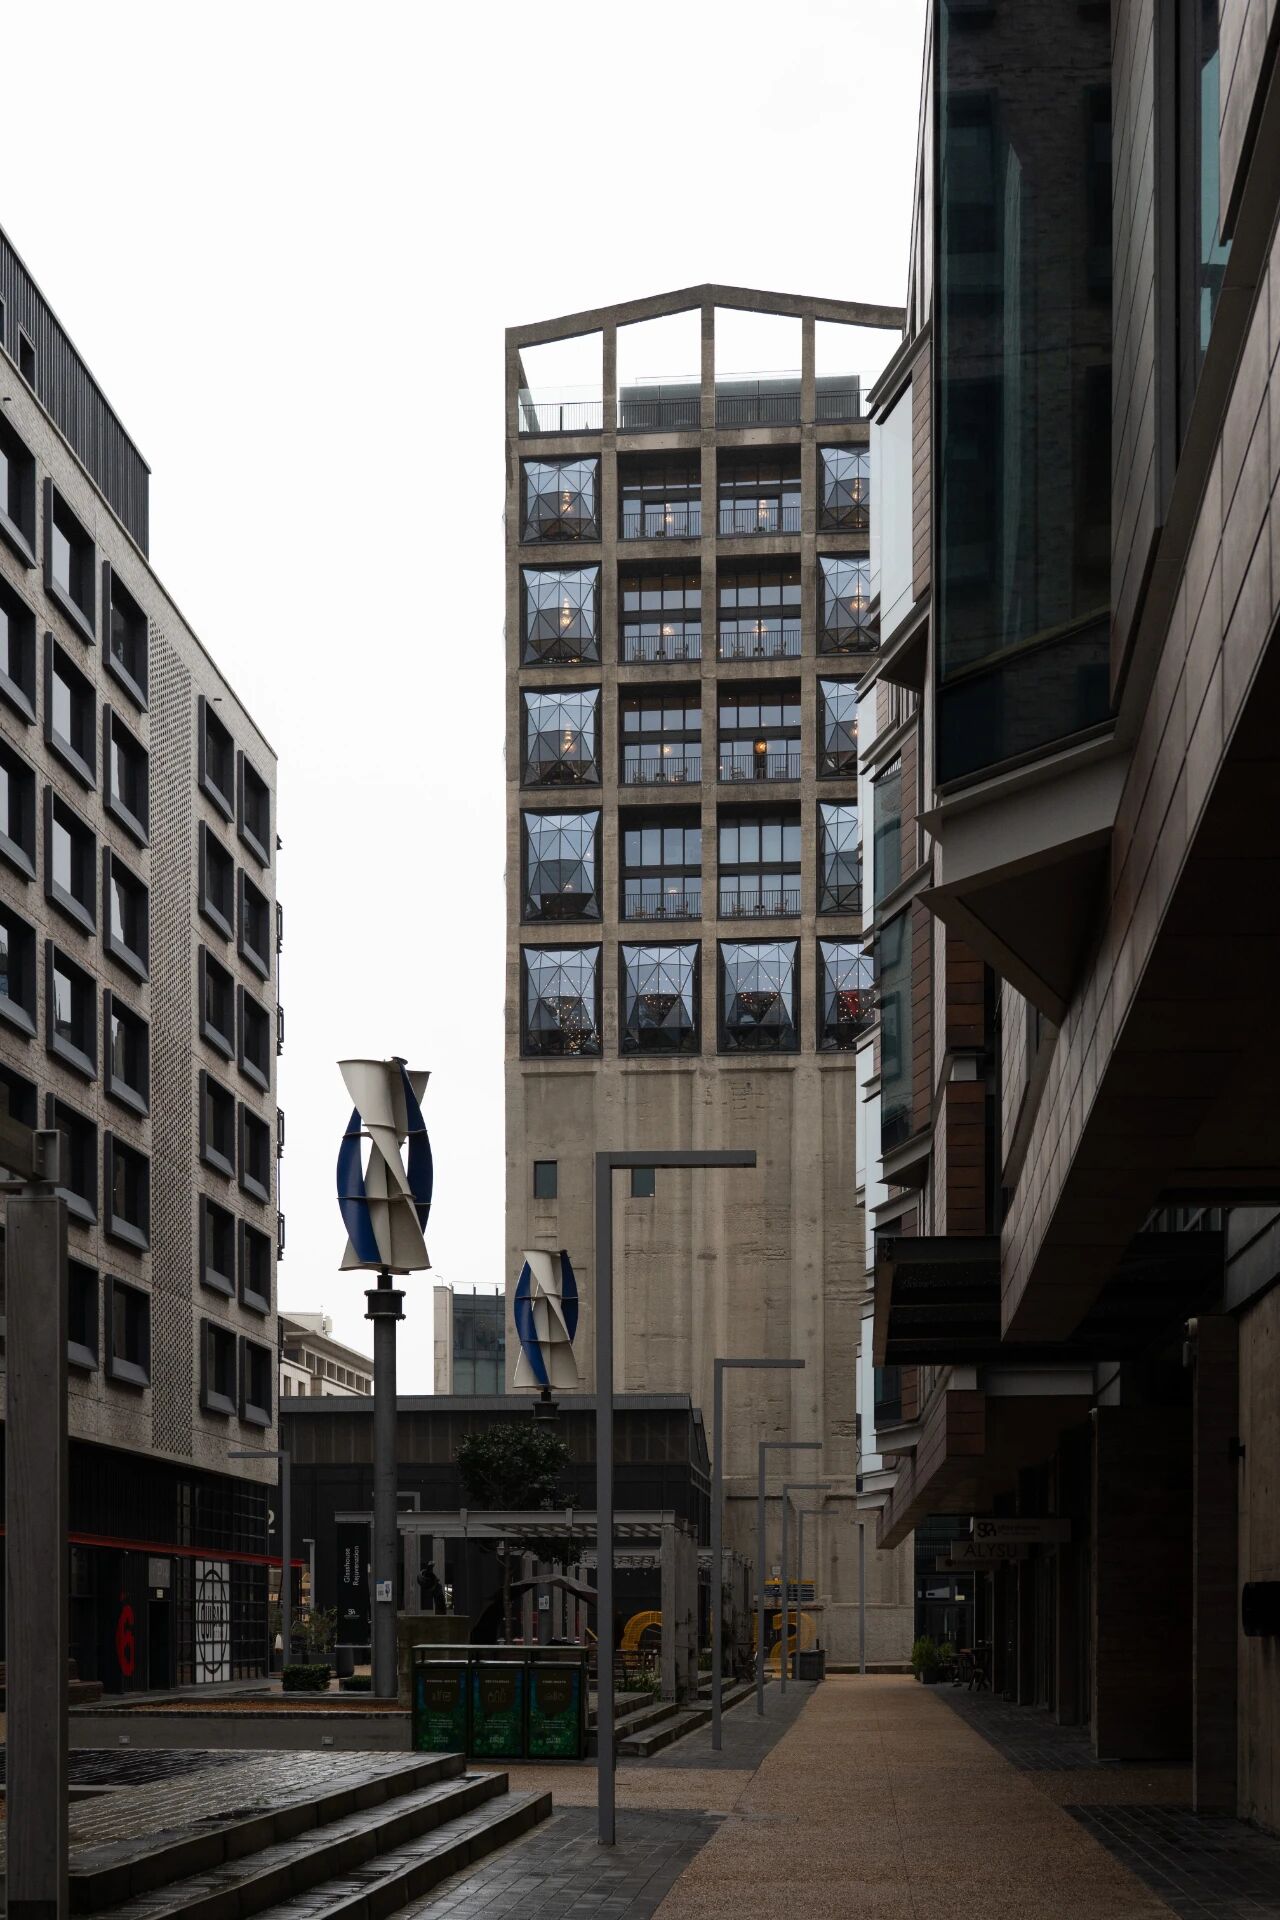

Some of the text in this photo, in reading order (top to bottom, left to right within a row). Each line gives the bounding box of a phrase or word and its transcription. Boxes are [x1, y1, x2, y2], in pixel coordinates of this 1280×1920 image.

[343, 1548, 351, 1583] Glasshouse
[352, 1545, 361, 1586] Rejuvenation
[115, 1602, 136, 1678] 6
